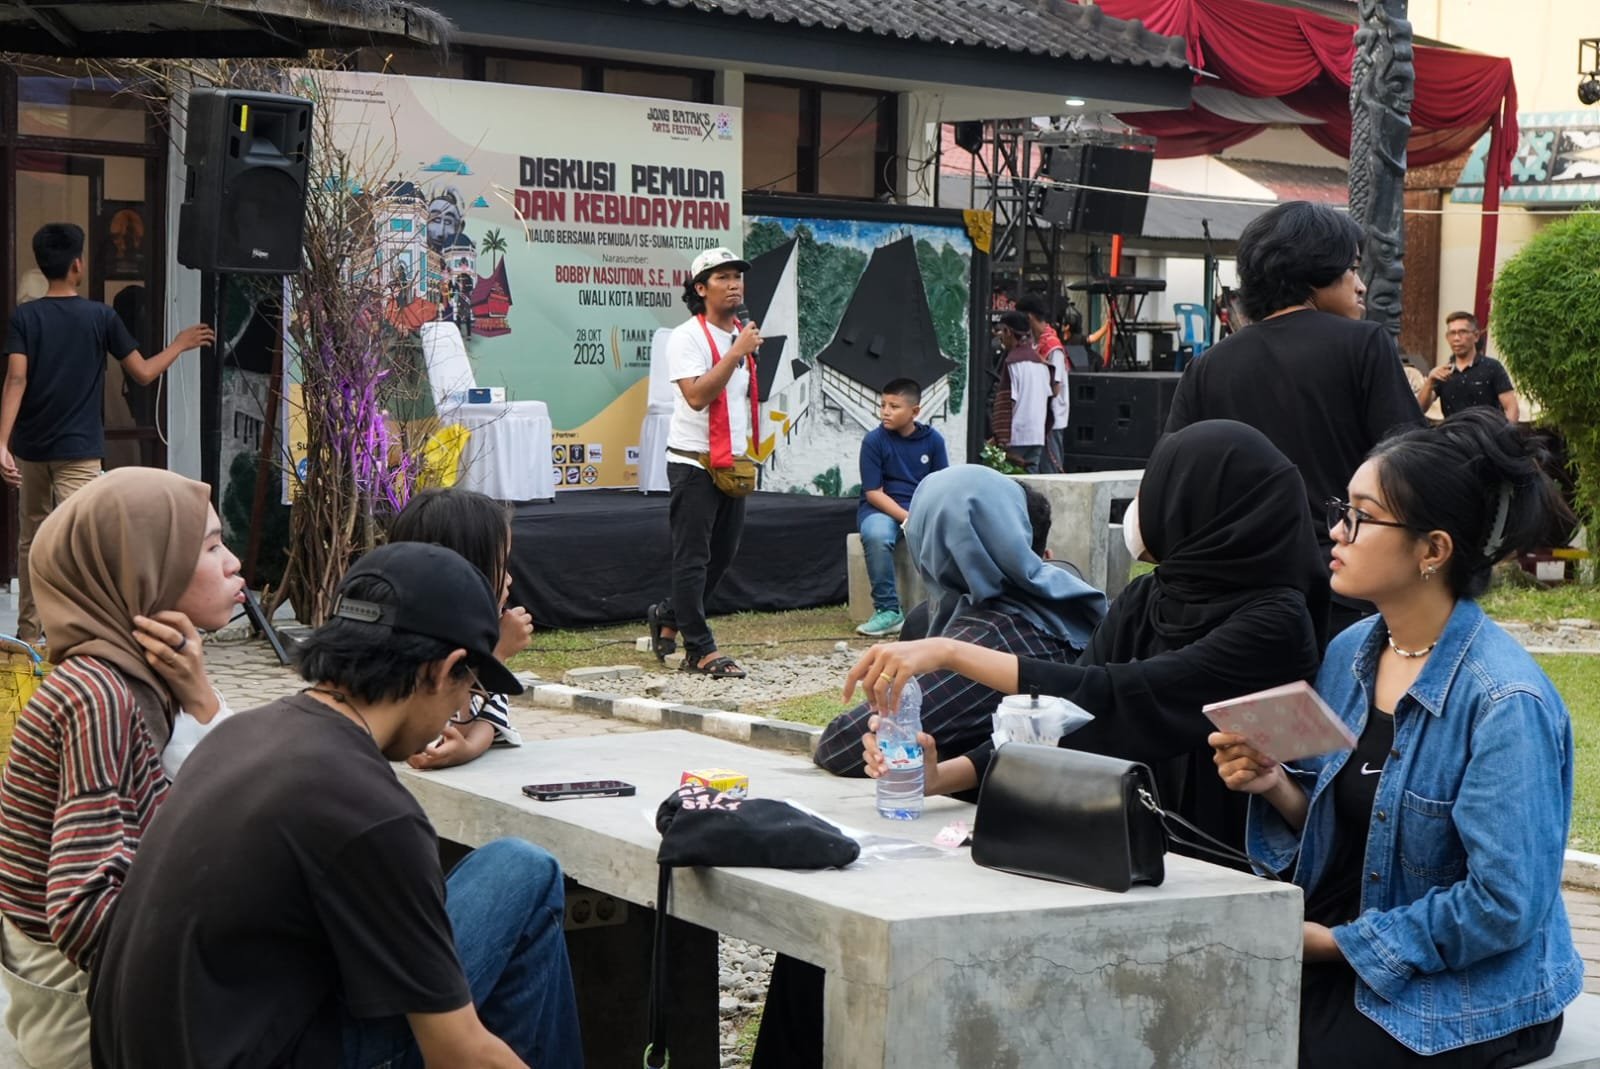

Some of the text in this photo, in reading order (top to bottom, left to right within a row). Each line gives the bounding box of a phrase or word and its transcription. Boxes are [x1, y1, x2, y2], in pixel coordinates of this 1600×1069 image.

[647, 108, 710, 125] JONG BATAK'S
[652, 122, 702, 136] ARTS FESTIVAL
[519, 156, 725, 199] DISKUSI PEMUDA
[514, 189, 730, 231] DAN KEBUDAYAAN
[557, 230, 596, 245] BERSAMA
[597, 232, 638, 247] PEMUDA/I
[639, 234, 693, 249] SE-SUMATERA
[695, 237, 720, 250] UTARA
[602, 253, 649, 265] Narasumber:
[555, 265, 591, 284] BOBBY
[593, 266, 646, 288] NASUTION,
[649, 268, 670, 289] S.E.,
[608, 291, 634, 306] KOTA
[576, 329, 602, 342] 28 OKT
[622, 329, 647, 342] TAMAN
[574, 343, 605, 365] 2023
